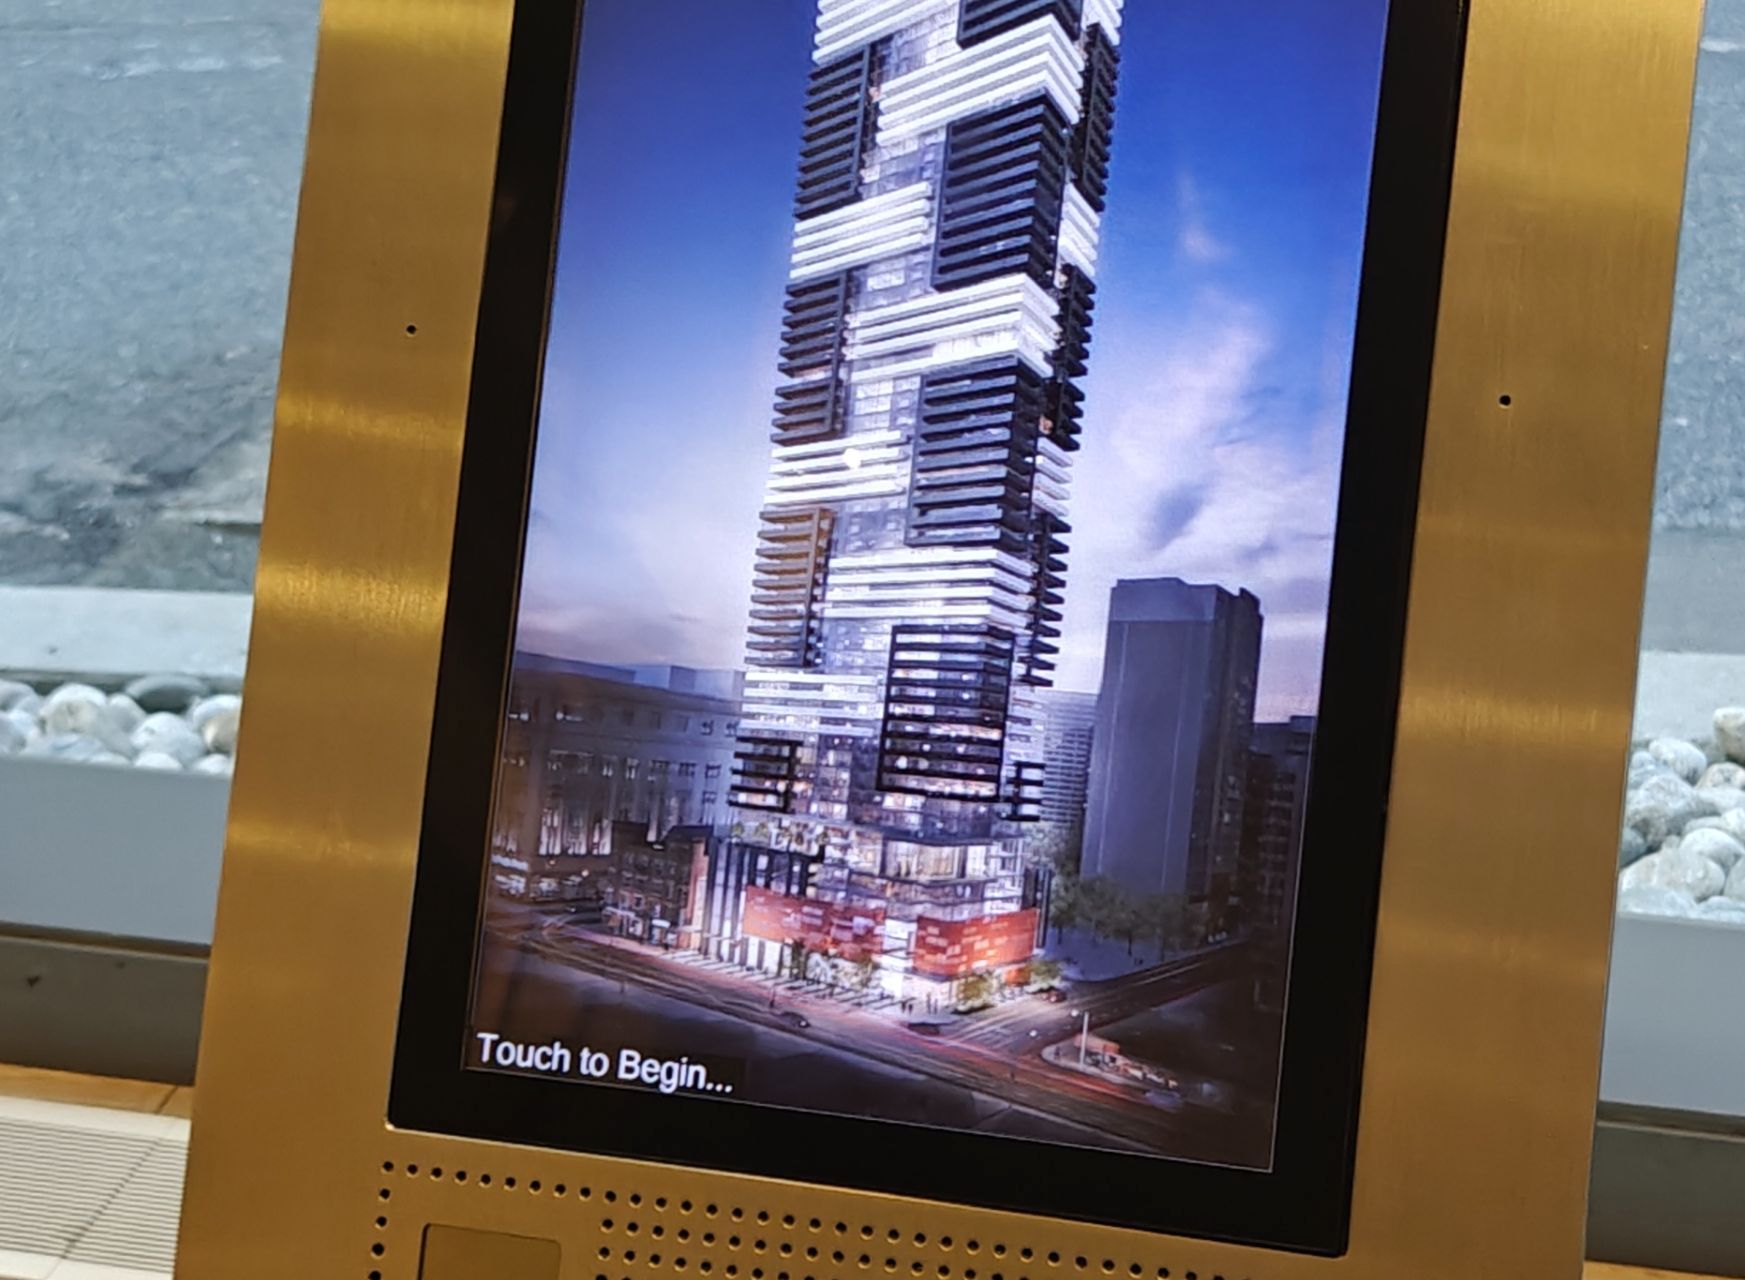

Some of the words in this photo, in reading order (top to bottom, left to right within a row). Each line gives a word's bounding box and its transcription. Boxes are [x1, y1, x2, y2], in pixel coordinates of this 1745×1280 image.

[476, 1032, 571, 1072] Touch
[579, 1047, 610, 1077] to
[617, 1049, 733, 1093] Begin...
